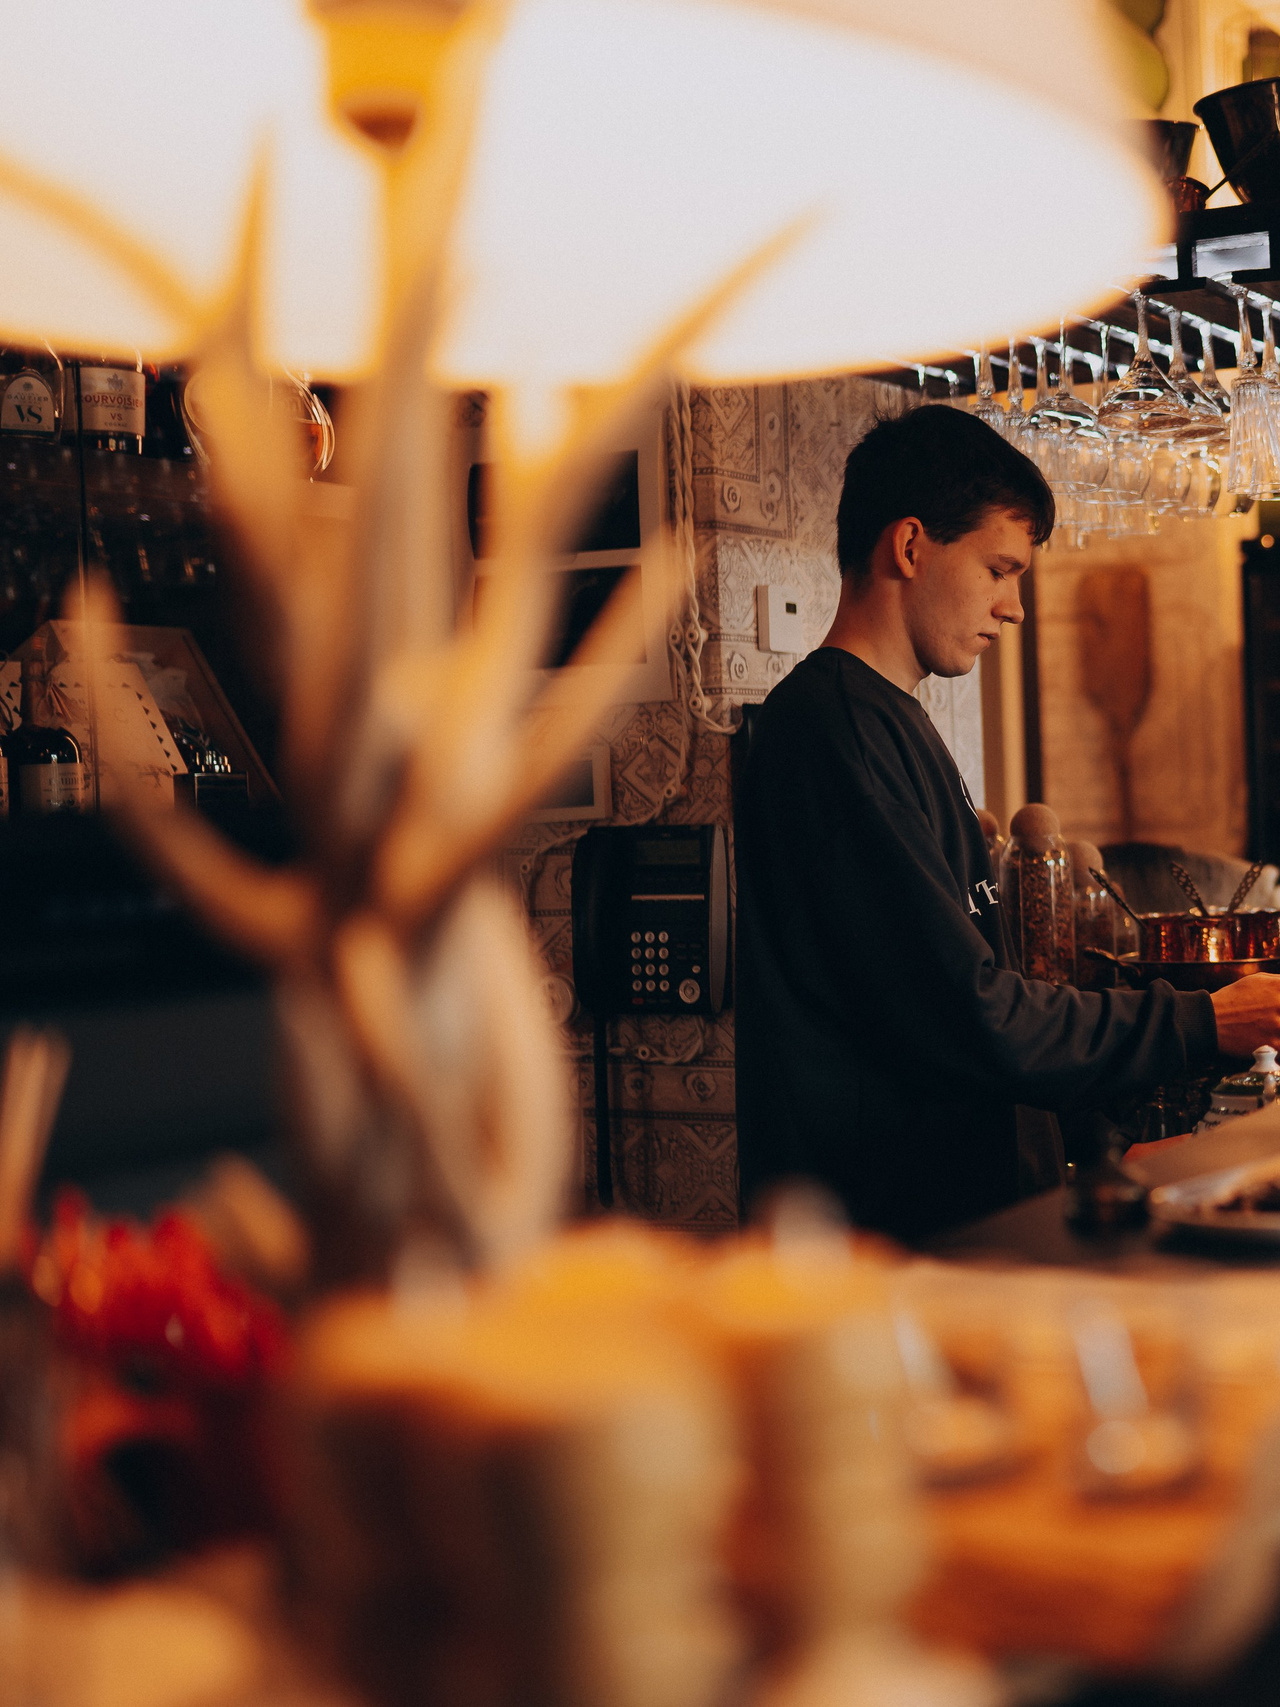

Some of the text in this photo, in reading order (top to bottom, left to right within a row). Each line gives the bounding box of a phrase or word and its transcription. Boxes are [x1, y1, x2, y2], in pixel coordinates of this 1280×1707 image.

[7, 394, 49, 402] GAUTIER
[82, 394, 143, 408] OURVOISIE
[14, 404, 43, 424] VS
[110, 412, 123, 421] VS
